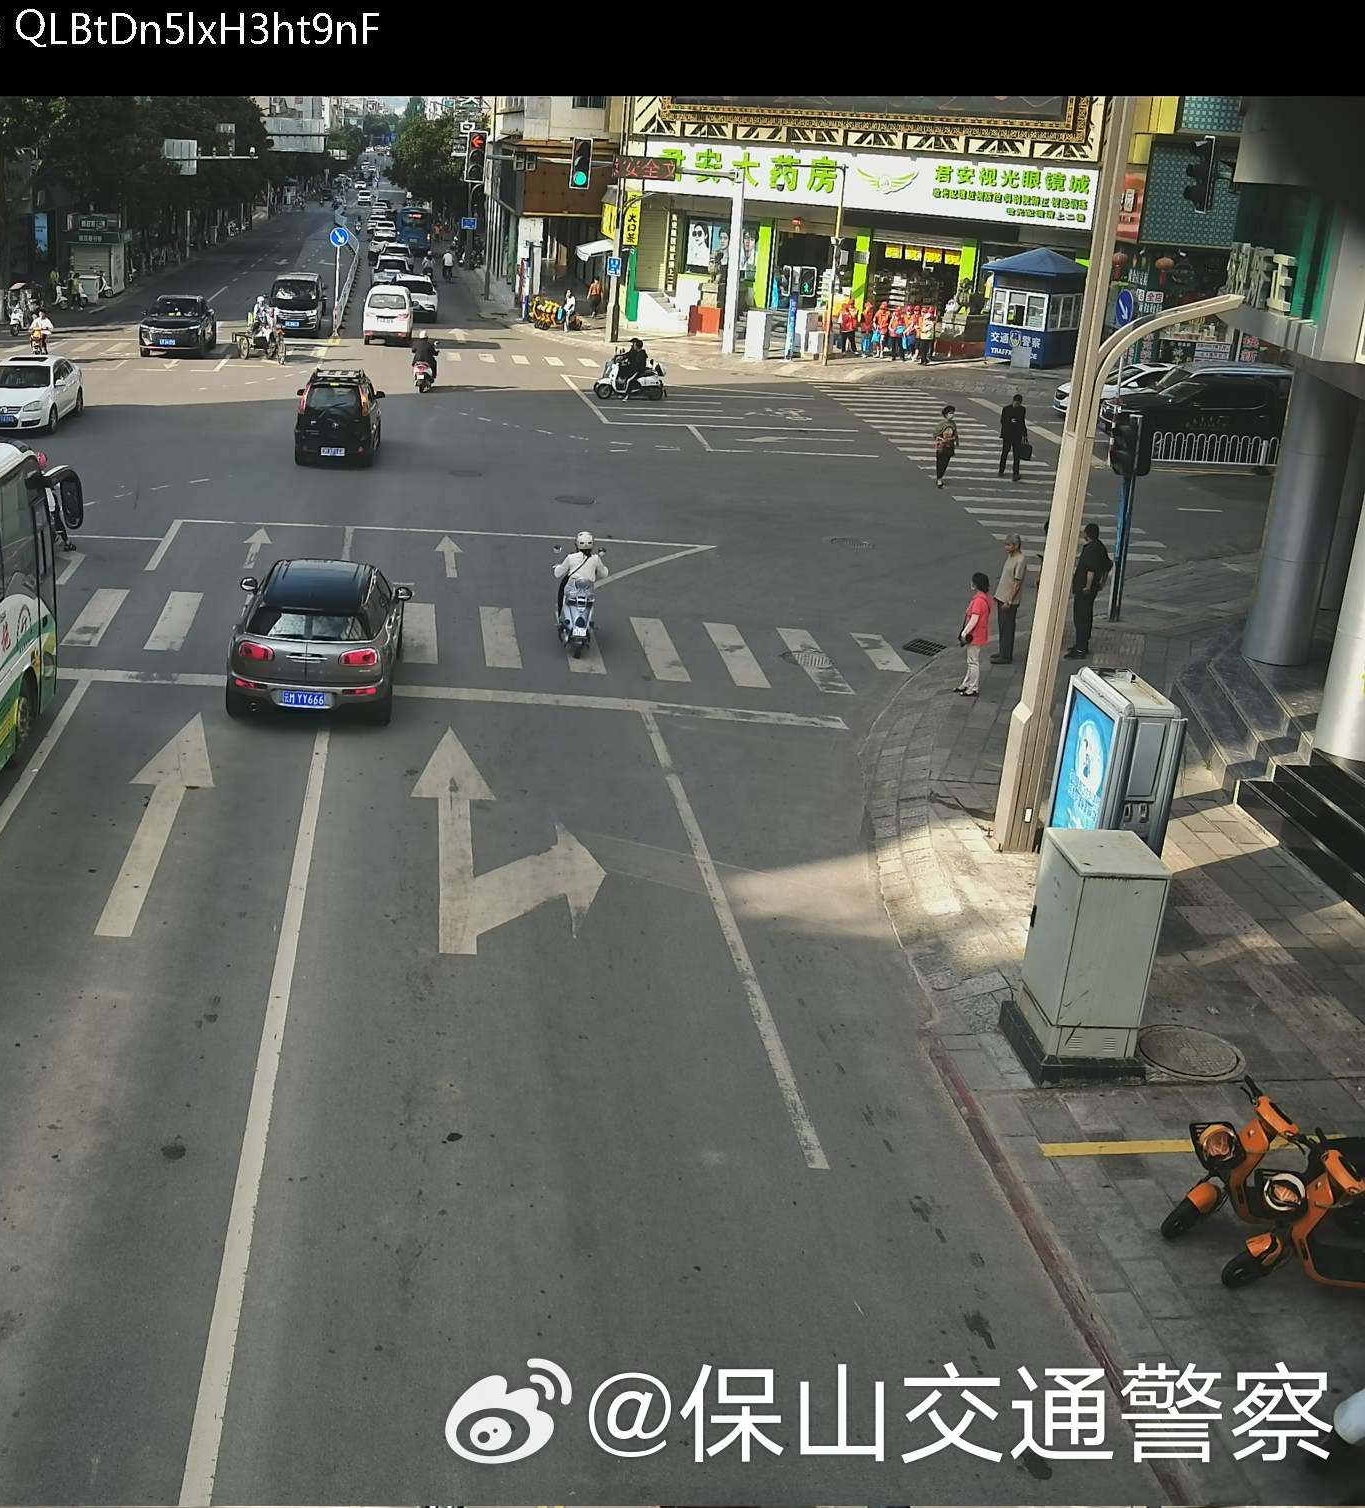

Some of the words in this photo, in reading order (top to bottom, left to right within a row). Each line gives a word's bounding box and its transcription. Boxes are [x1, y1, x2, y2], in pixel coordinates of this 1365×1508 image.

[935, 165, 1091, 195] 君安视光眼镜城
